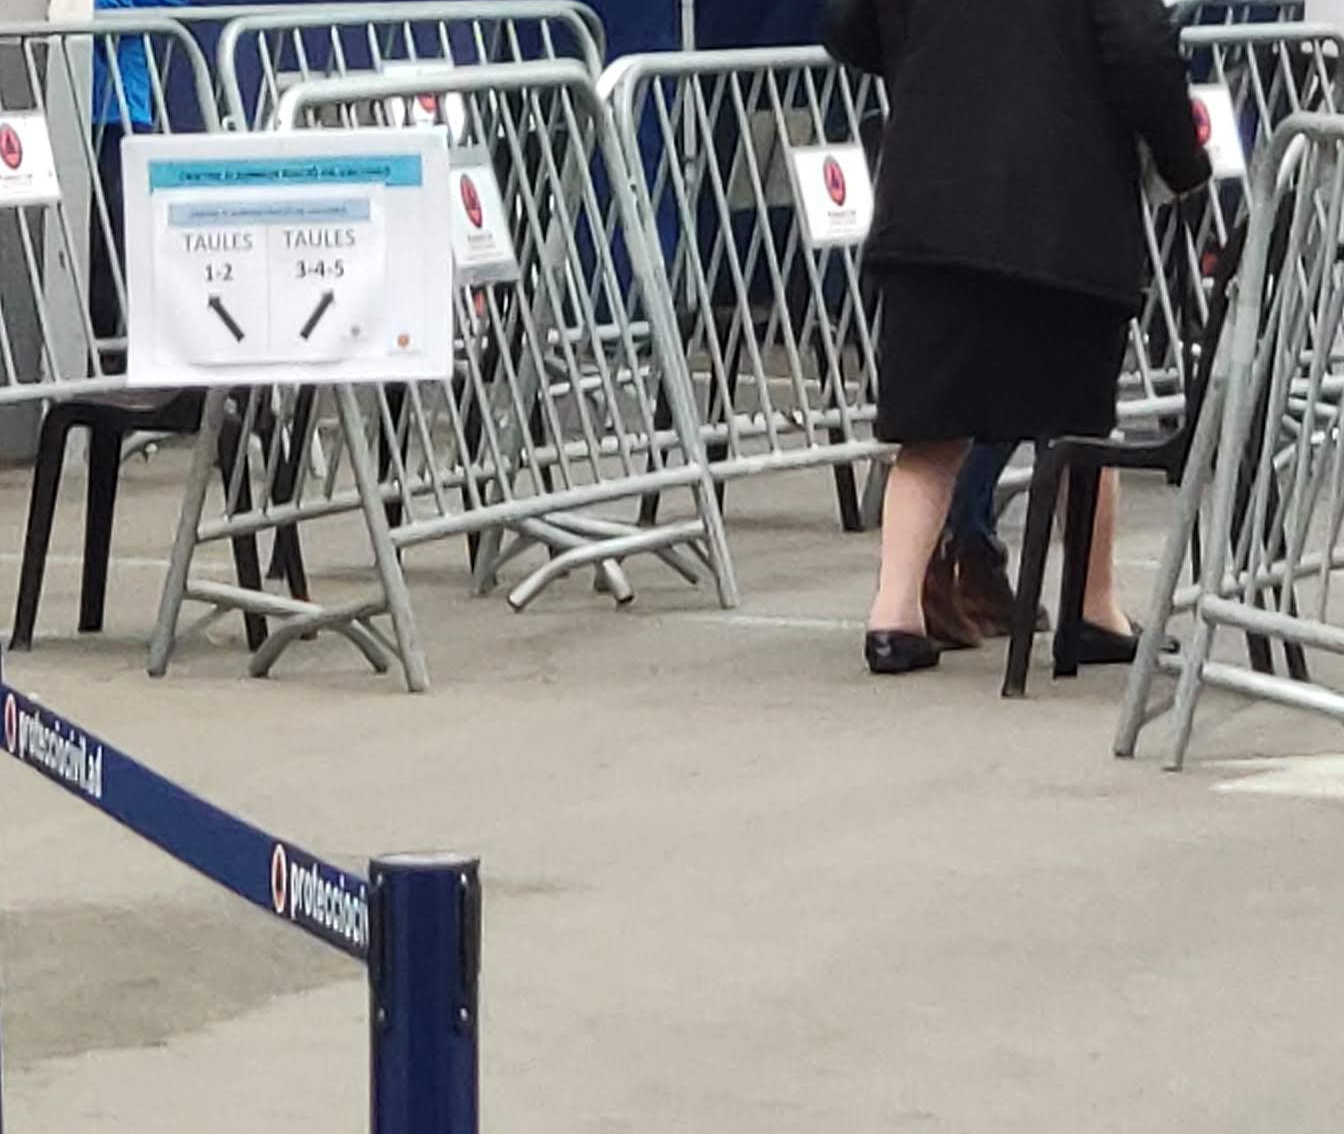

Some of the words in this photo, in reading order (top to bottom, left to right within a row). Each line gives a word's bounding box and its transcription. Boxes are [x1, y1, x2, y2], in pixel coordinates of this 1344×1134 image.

[183, 232, 254, 252] TAULES
[283, 227, 357, 249] TAULES
[205, 263, 234, 282] 1-2
[295, 258, 346, 278] 3-4-5
